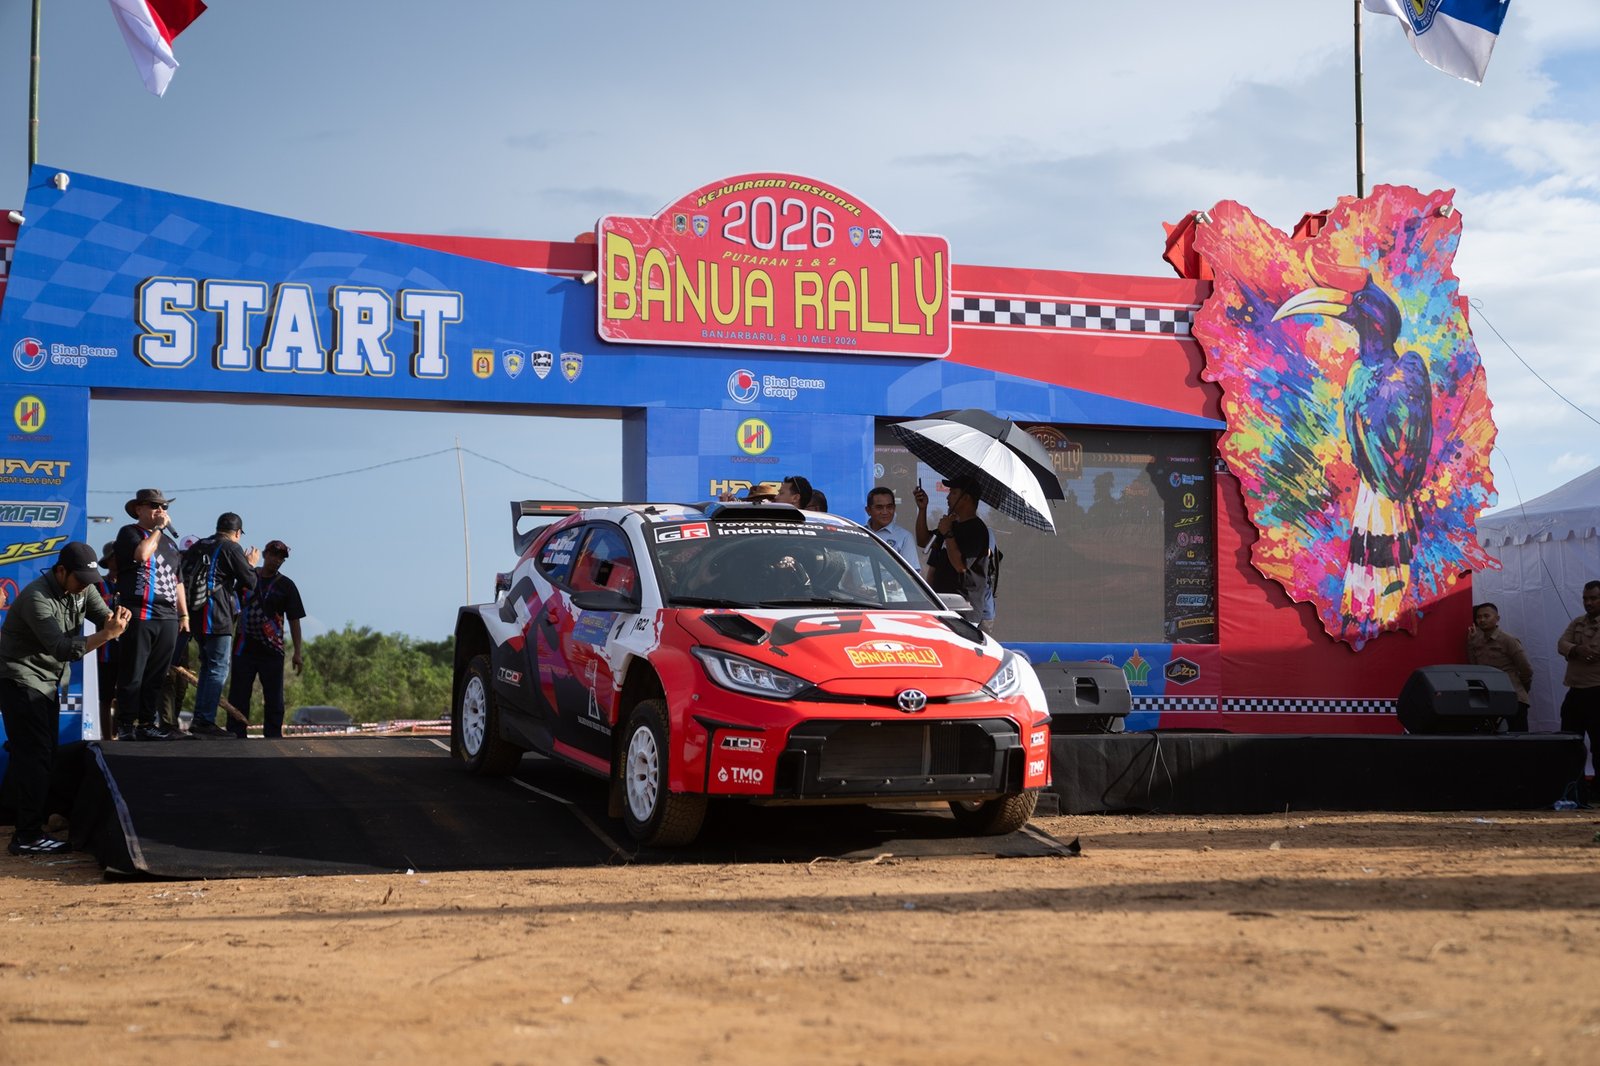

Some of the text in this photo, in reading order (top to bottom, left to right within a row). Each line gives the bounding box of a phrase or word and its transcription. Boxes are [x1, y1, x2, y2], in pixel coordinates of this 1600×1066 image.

[697, 179, 863, 217] KEJUARAAN NASIONAL
[722, 196, 835, 251] 2026
[722, 251, 837, 267] PUTARAN 1 & 2
[606, 231, 944, 336] BANUA RALLY
[137, 276, 463, 379] START
[780, 334, 786, 342] 8
[797, 335, 807, 343] 10
[811, 336, 831, 344] MEI
[835, 337, 857, 345] 2026
[51, 344, 118, 357] Bina Benua
[51, 355, 87, 368] Group
[763, 375, 825, 389] Bina Benua
[763, 386, 798, 400] Group
[658, 527, 710, 542] GR
[715, 521, 870, 538] TOYOTA GAZOO Racing
[718, 528, 816, 537] Indonesia
[0, 536, 69, 559] JRT
[614, 621, 626, 640] 1
[848, 649, 937, 664] BANUA RALLY
[725, 737, 762, 749] TCD
[730, 767, 764, 782] TMO
